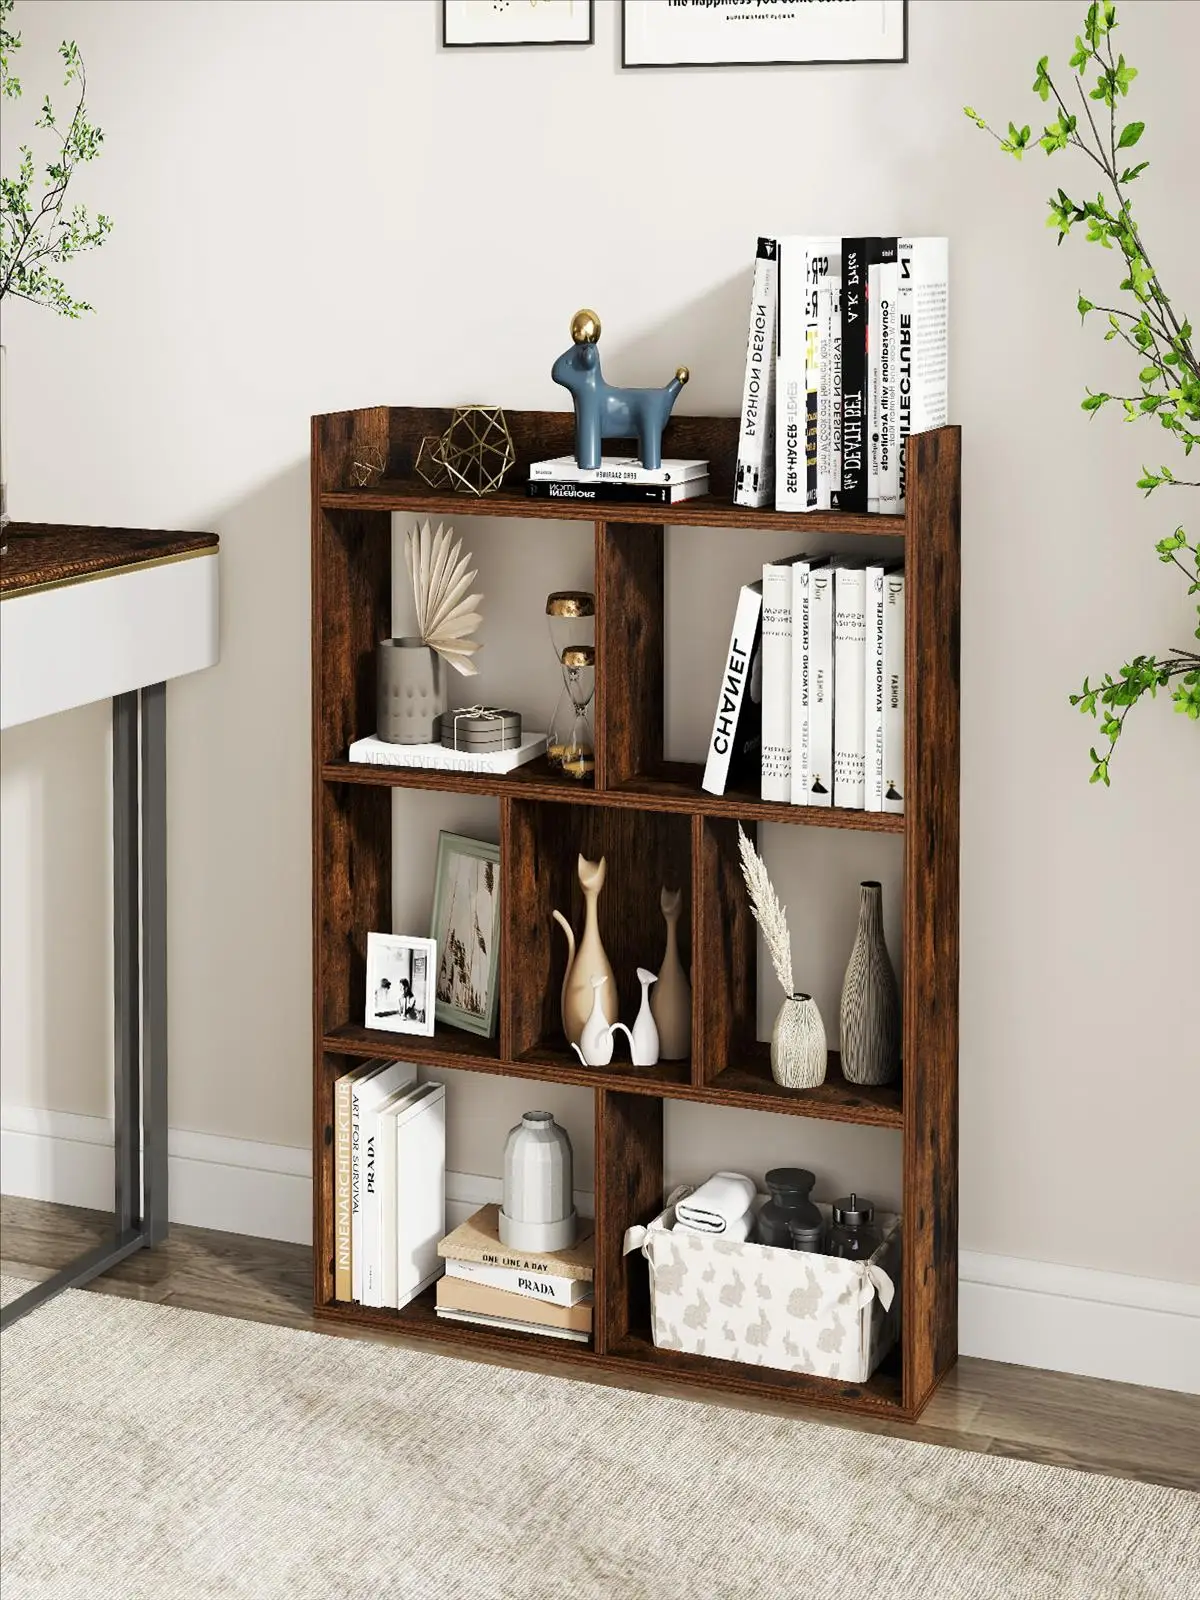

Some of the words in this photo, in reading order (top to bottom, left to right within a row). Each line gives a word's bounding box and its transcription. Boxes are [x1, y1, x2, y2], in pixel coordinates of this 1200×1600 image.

[814, 578, 828, 601] Dior
[888, 582, 903, 606] Dior
[890, 674, 898, 708] FASHION
[444, 757, 494, 772] STORIES
[339, 1081, 351, 1271] INNENARCHITEKTUR
[366, 1136, 375, 1194] PRADA
[482, 1254, 498, 1264] ONE
[502, 1257, 521, 1268] LINE
[523, 1260, 530, 1269] A
[531, 1262, 548, 1272] DAY
[518, 1277, 556, 1297] PRADA
